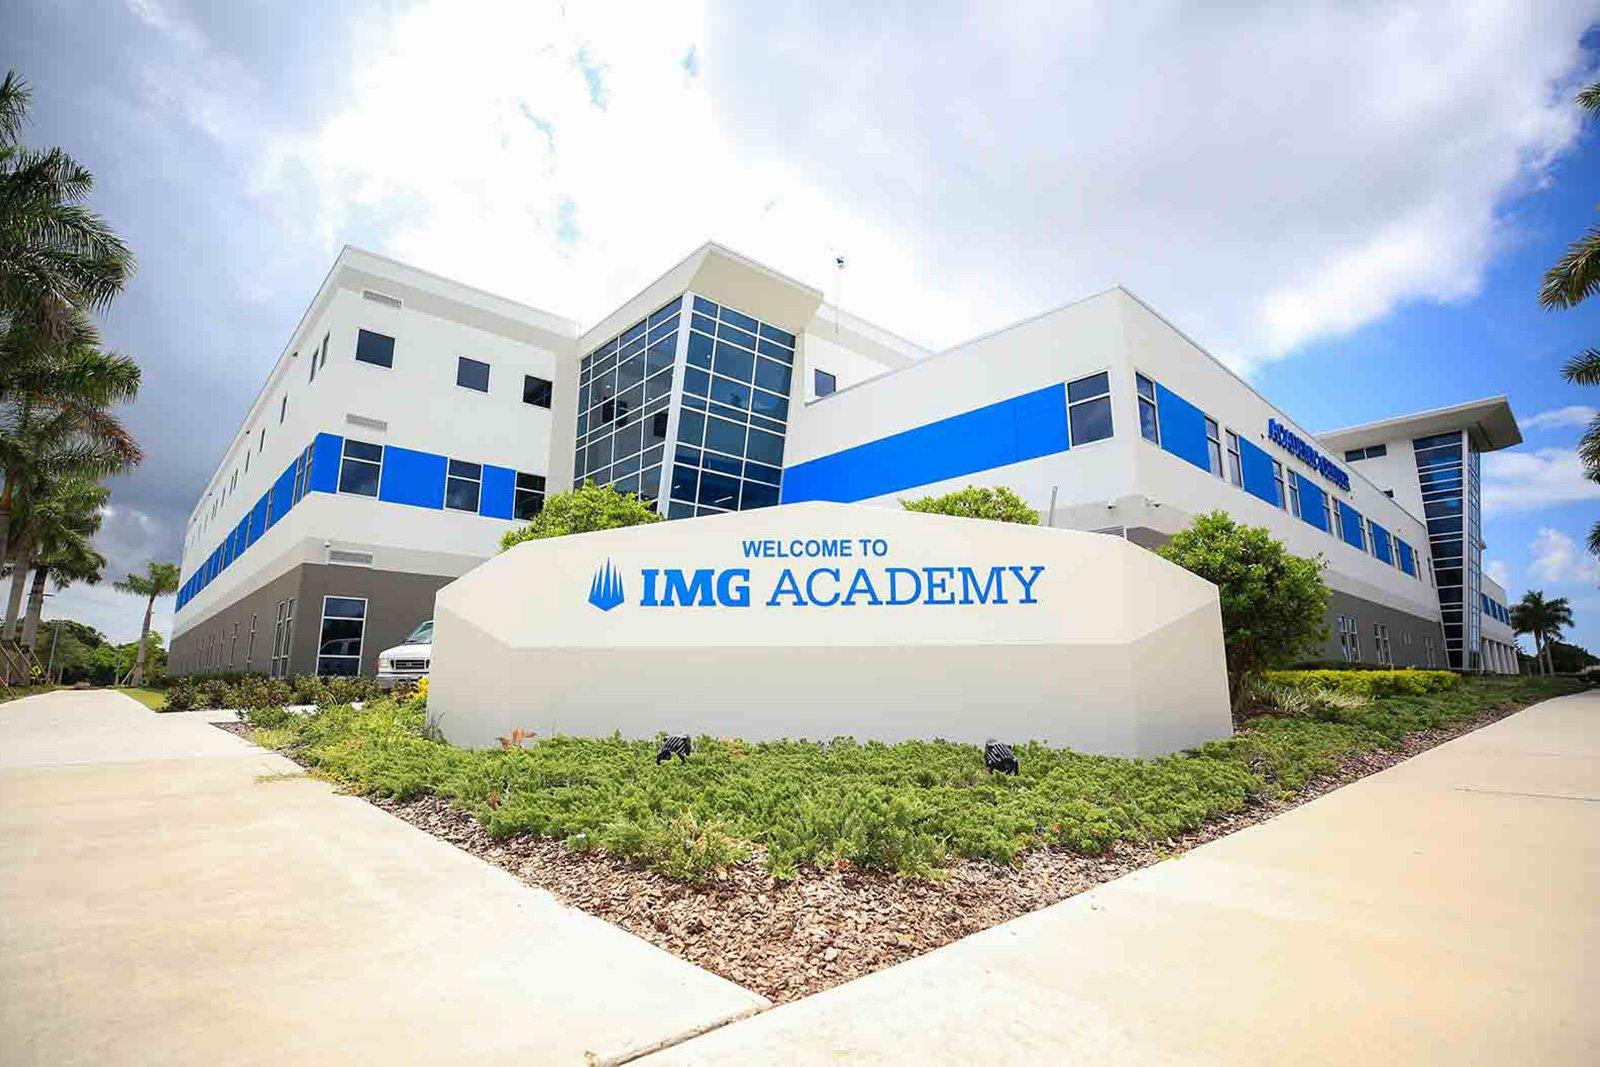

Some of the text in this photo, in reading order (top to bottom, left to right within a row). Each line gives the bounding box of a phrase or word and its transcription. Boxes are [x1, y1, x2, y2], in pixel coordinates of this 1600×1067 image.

[742, 539, 888, 558] WELCOME TO
[640, 566, 1045, 608] IMG ACADEMY
